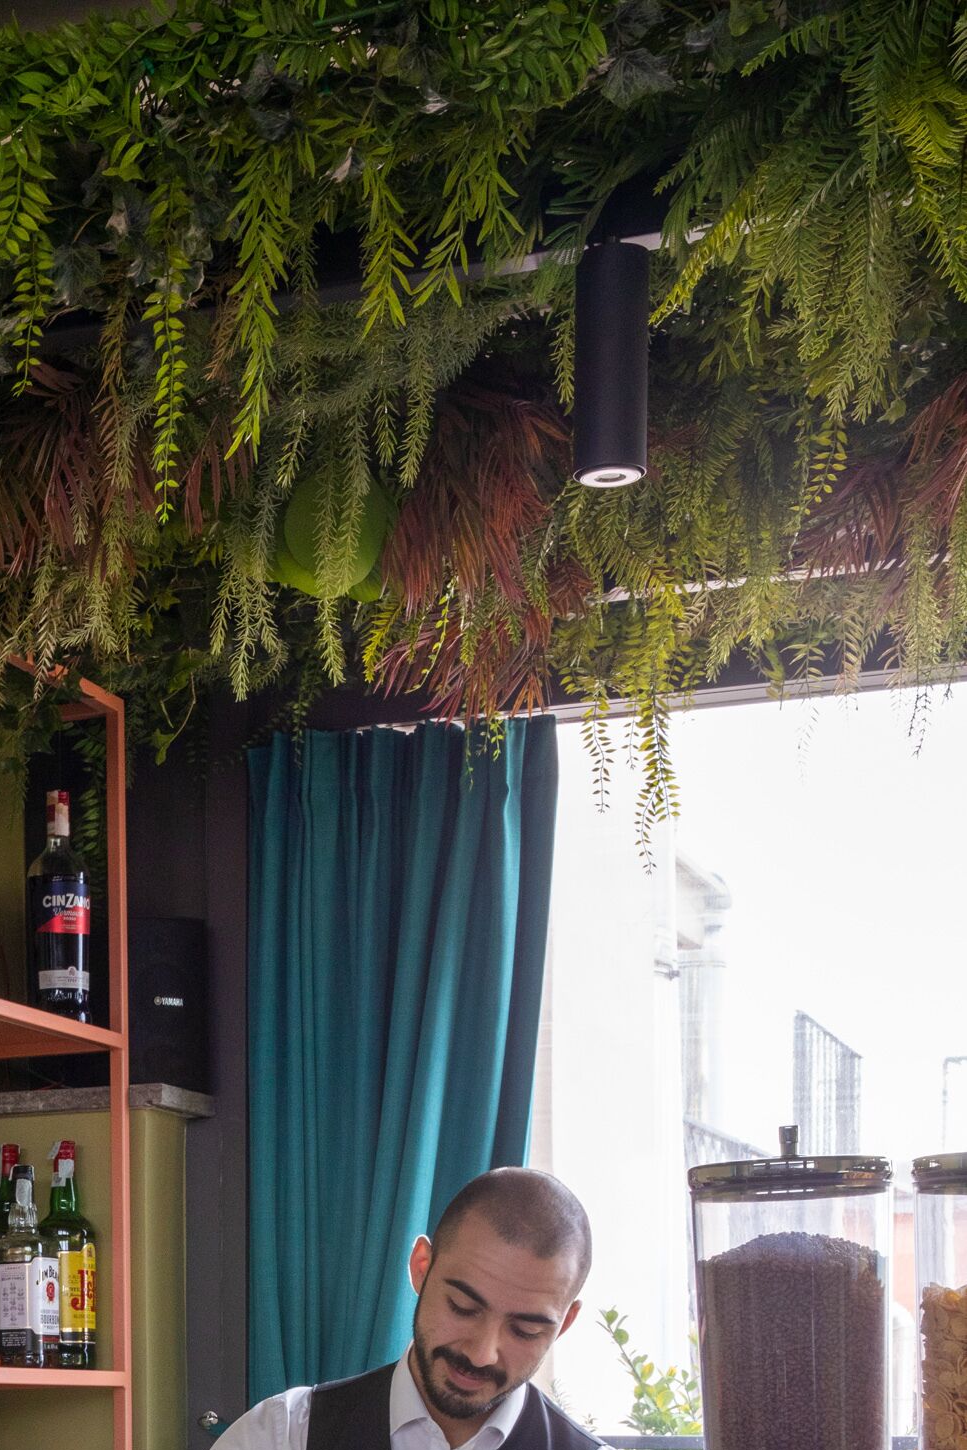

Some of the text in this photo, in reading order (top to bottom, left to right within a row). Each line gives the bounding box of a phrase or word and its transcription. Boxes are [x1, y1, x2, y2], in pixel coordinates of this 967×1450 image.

[42, 893, 91, 910] CINZANO
[161, 997, 184, 1007] YAMAHA
[48, 1264, 59, 1279] BEA
